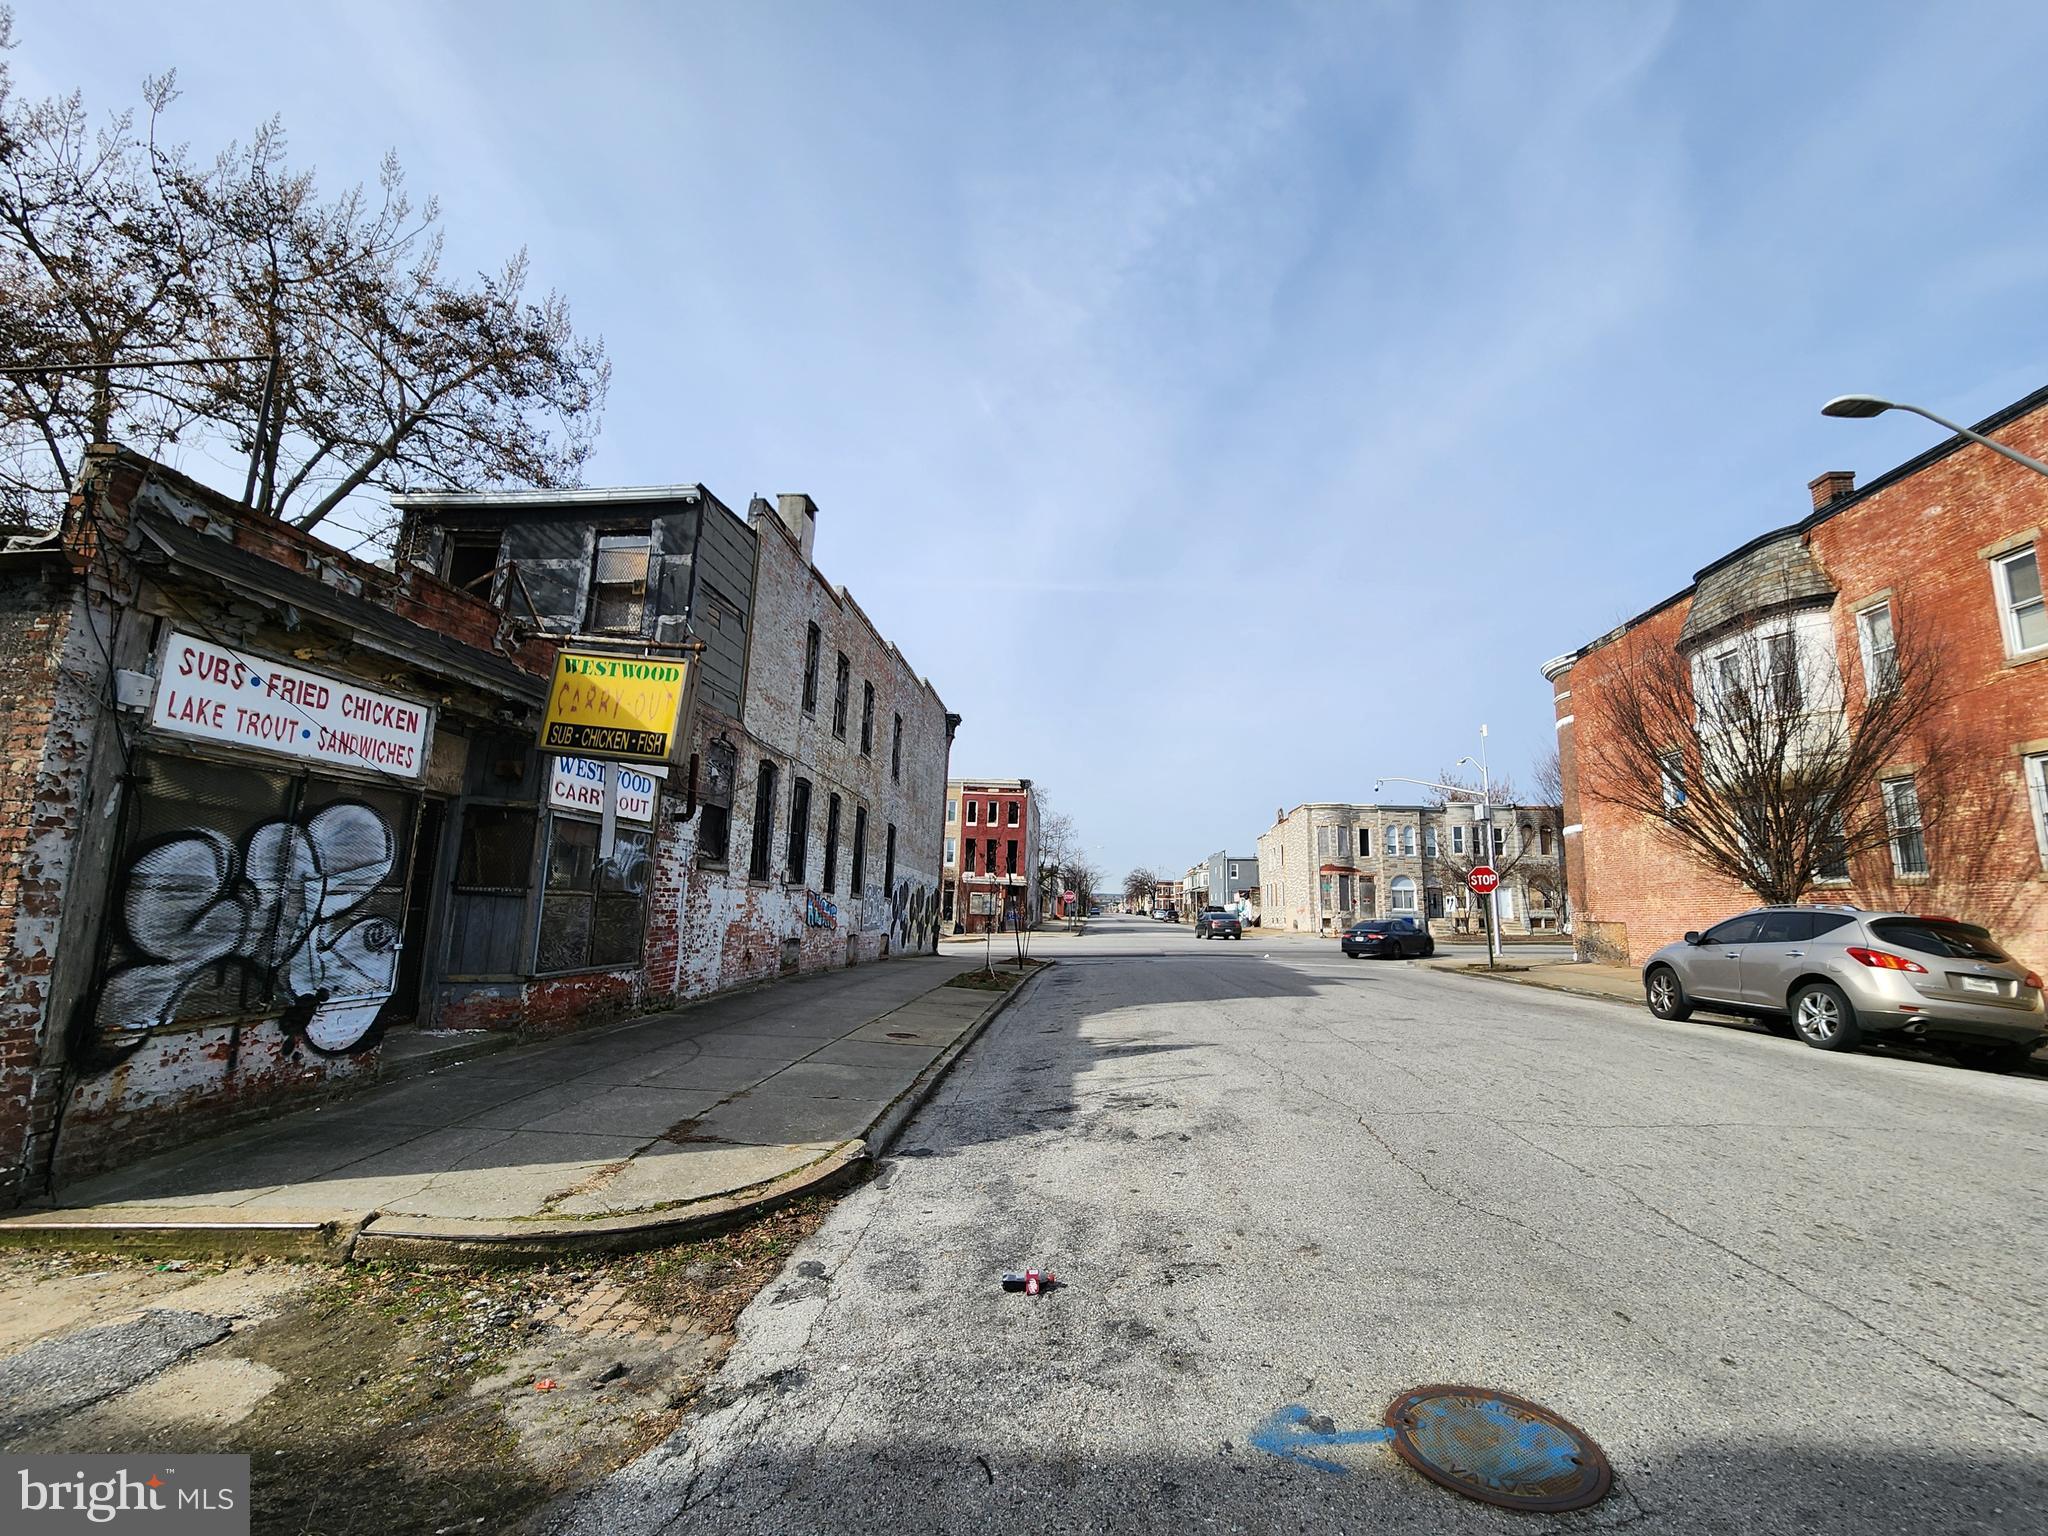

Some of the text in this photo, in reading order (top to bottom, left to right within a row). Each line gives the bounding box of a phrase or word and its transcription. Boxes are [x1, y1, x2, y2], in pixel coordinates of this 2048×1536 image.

[564, 657, 680, 682] WESTWOOD
[178, 648, 419, 734] SUBS FRIED CHICKEN
[167, 690, 414, 769] LAKE TROUT SANDWICHES
[550, 725, 663, 753] SUB CHICKEN FISH
[560, 756, 651, 794] WESTOOD
[619, 796, 650, 815] OUT
[1470, 874, 1496, 886] STOP
[1455, 1397, 1536, 1424] WATER
[1448, 1463, 1546, 1497] VALVE
